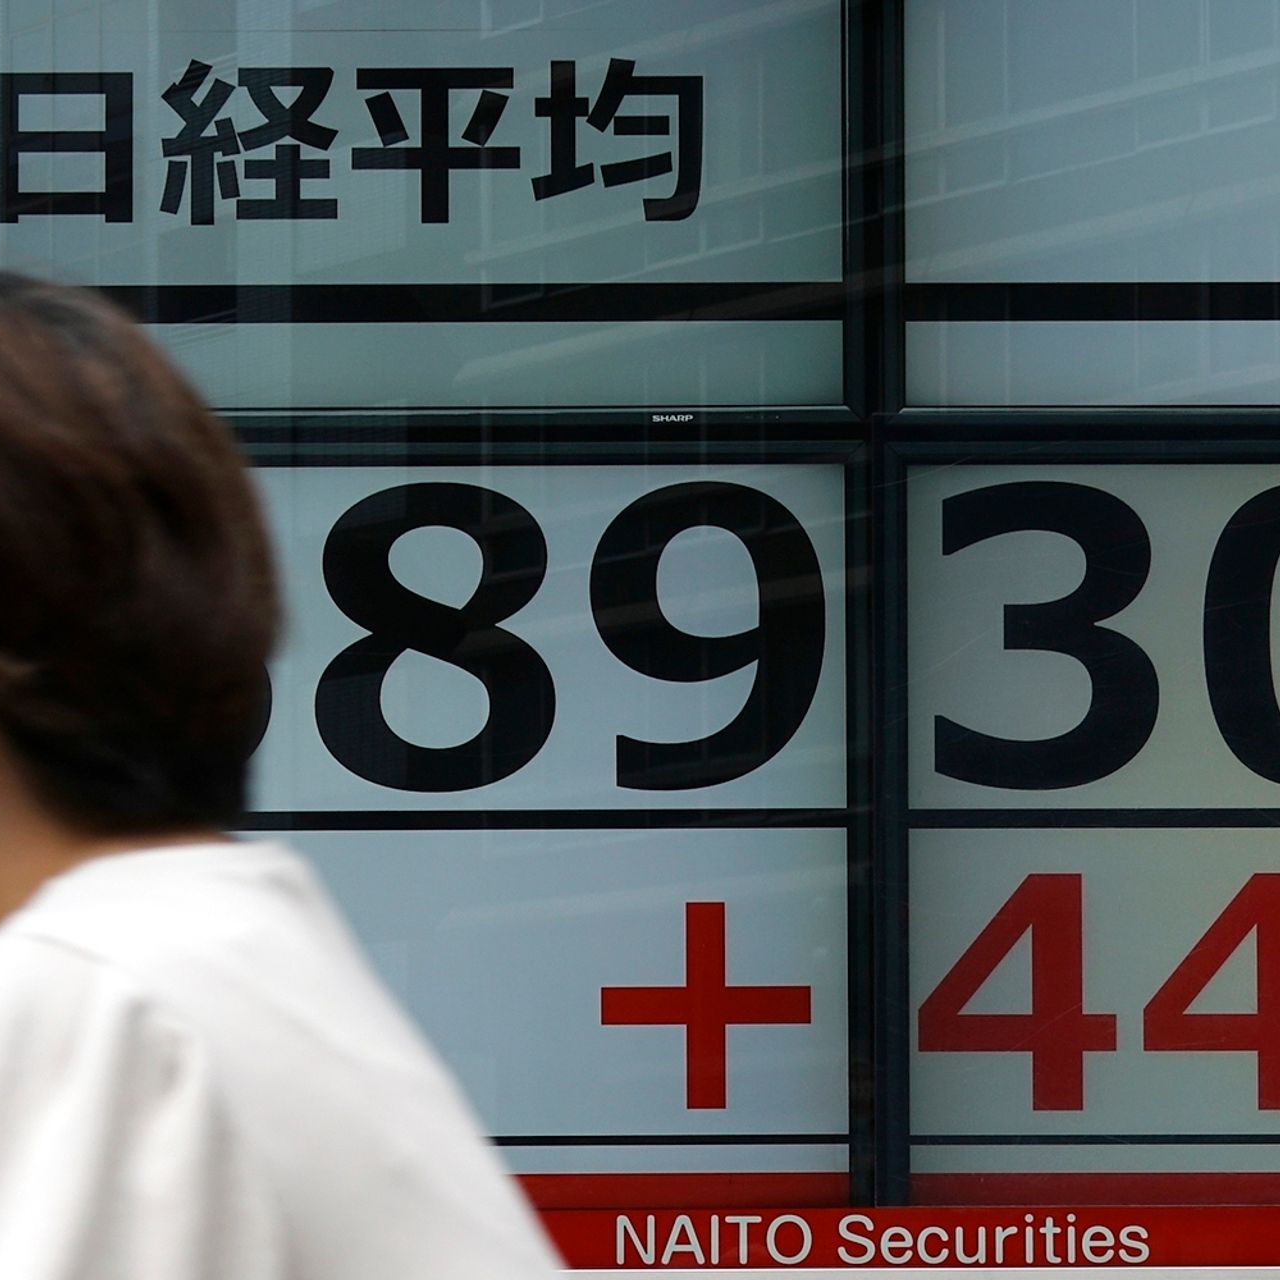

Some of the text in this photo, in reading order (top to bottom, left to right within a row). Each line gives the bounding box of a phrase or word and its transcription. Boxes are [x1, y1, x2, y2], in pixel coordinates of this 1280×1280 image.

[651, 413, 694, 423] SHARP
[615, 1212, 1151, 1266] NAITO Securities
